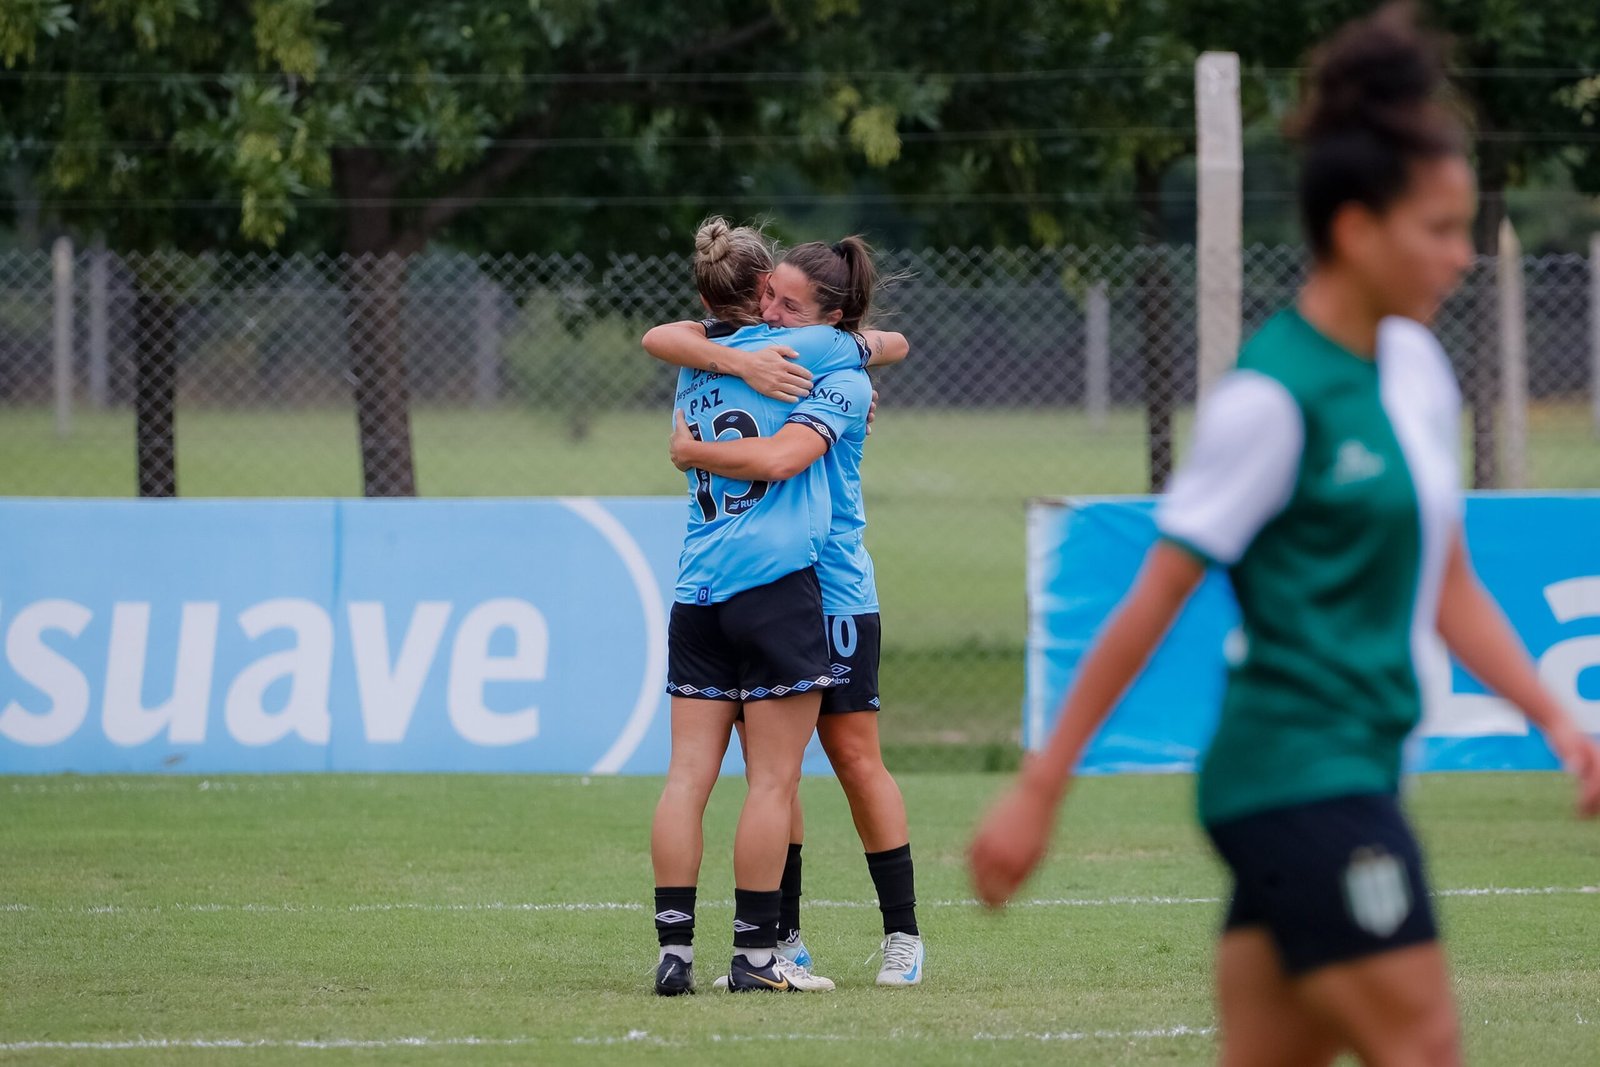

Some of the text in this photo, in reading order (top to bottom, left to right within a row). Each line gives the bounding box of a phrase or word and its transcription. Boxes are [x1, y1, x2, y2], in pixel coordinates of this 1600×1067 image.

[690, 388, 723, 416] PAZ
[824, 615, 858, 659] 0
[0, 597, 549, 748] suave
